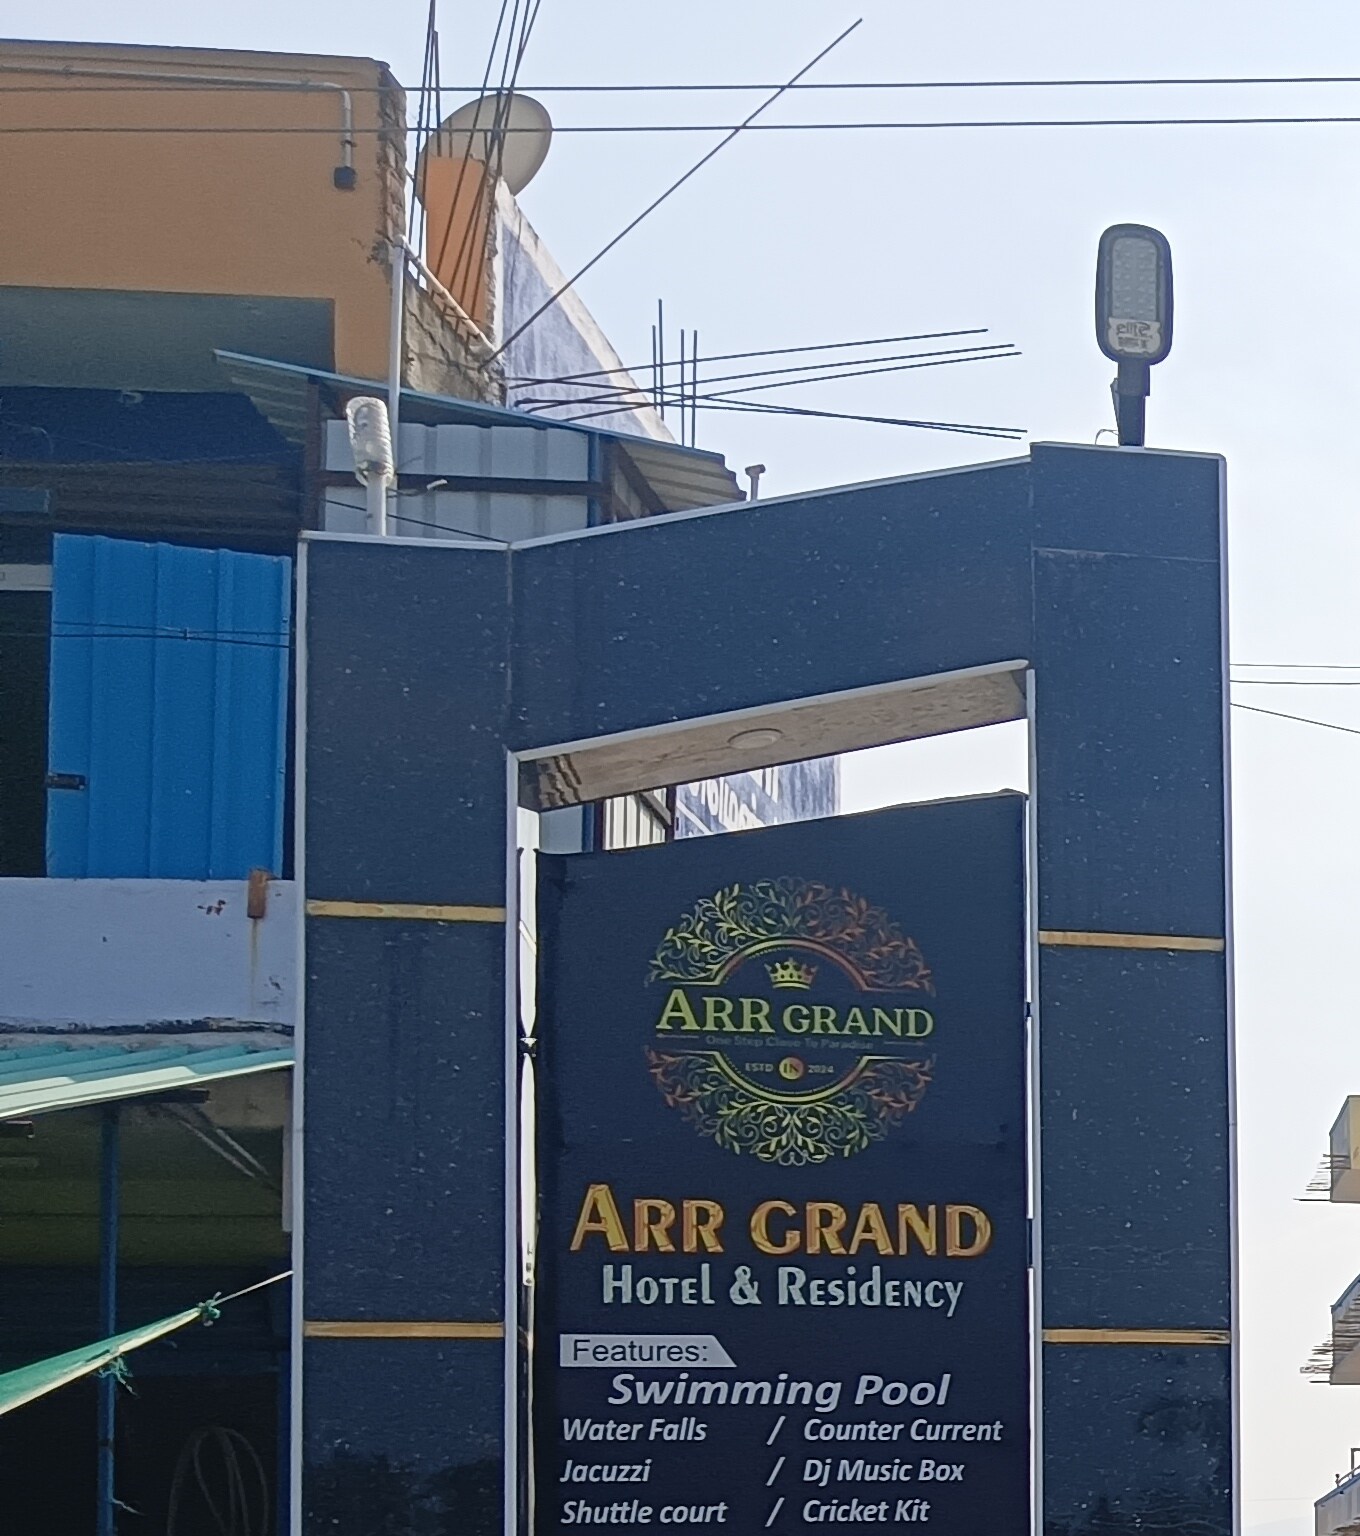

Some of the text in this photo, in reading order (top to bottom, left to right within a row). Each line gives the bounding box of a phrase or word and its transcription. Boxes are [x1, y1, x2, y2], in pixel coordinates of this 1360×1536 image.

[656, 989, 934, 1037] ARR GRAND
[570, 1184, 992, 1258] ARR GRAND
[730, 1266, 762, 1306] &
[572, 1339, 709, 1363] Features:
[608, 1372, 952, 1413] Swimming Pool
[562, 1416, 1004, 1446] Water Falls / Counter Current
[560, 1456, 965, 1487] Jacuzzi / Dj Music Box
[561, 1497, 930, 1528] Shuttle court / Cricket Kit
